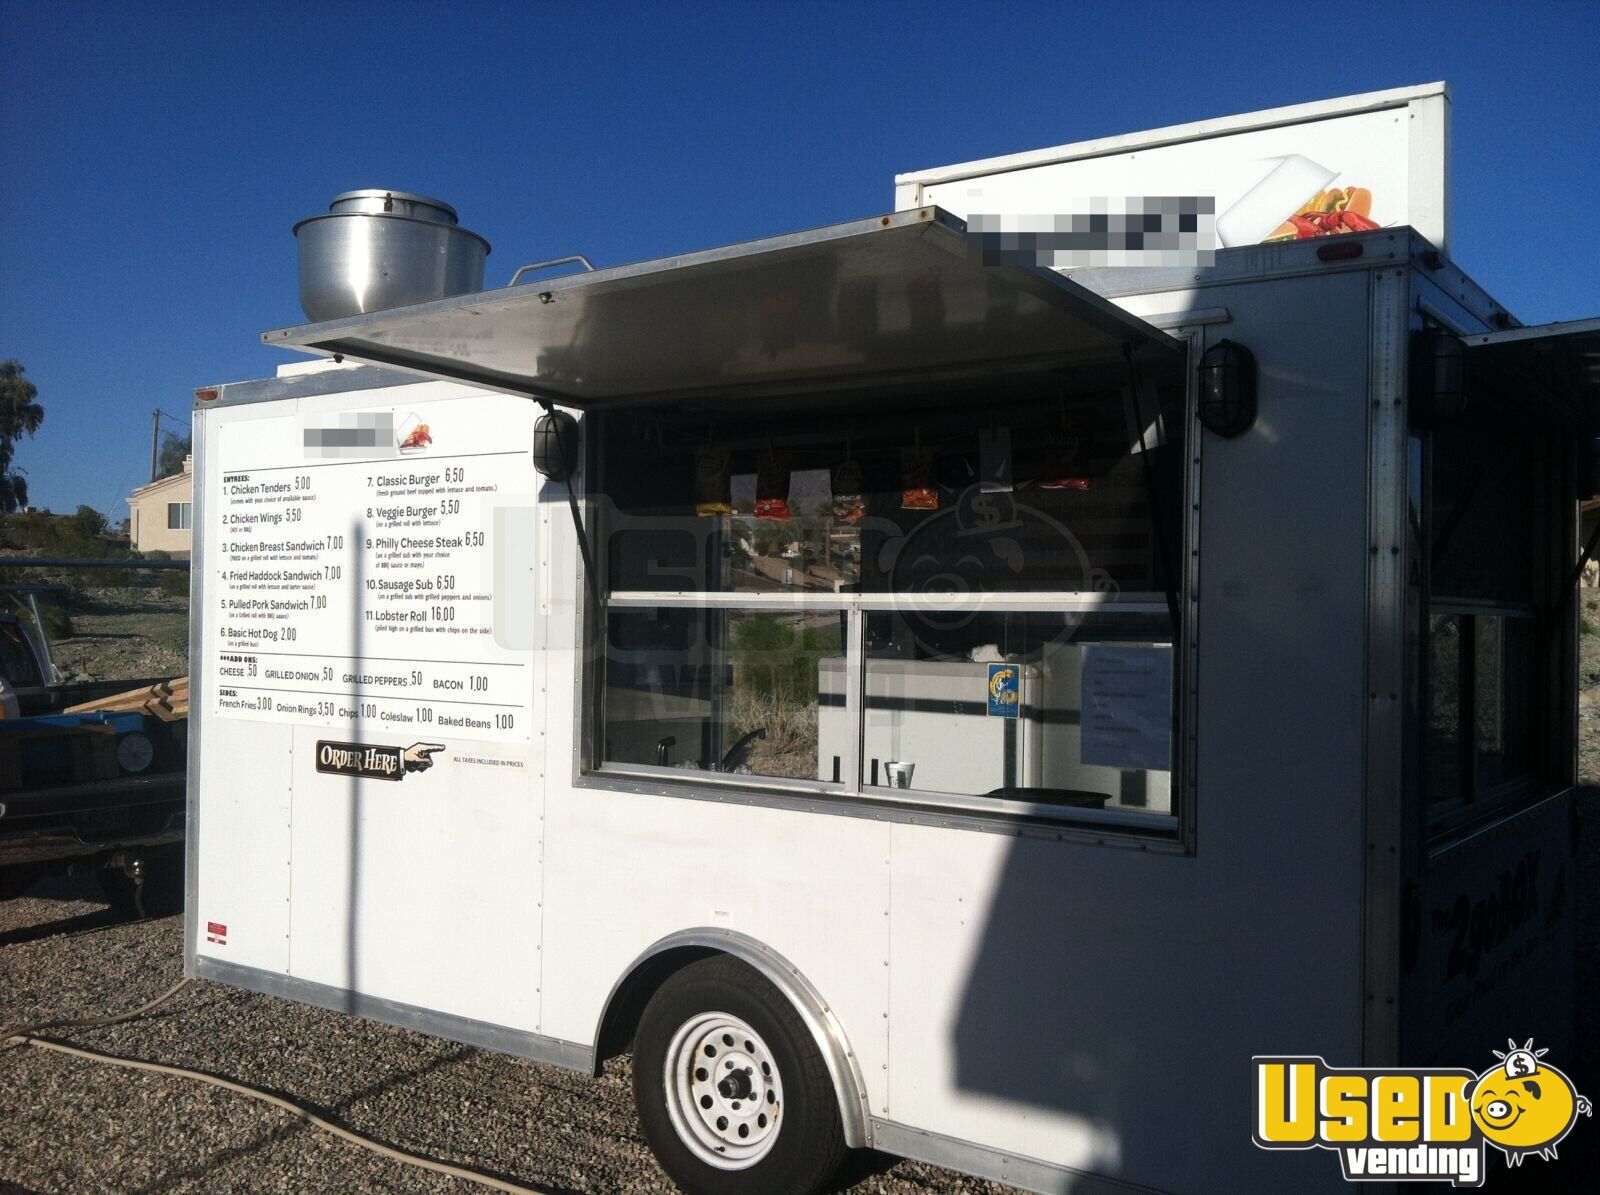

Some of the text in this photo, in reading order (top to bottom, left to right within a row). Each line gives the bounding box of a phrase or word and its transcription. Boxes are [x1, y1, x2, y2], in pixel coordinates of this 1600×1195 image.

[223, 476, 310, 495] 1. Chicken Tenders 5.00
[224, 475, 250, 483] ENTREES:
[367, 468, 464, 487] 7. Classic Burger 6.50
[223, 508, 301, 525] 2. Chicken Wings 5.50
[367, 500, 459, 520] 8. Veggie Burger 5.50
[222, 536, 343, 552] 3. Chicken Breast Sandwich 7.00
[367, 532, 484, 550] 9. Philly Cheese Steak 6.50
[222, 566, 341, 580] 4. Fried Haddock Sandwich 7.00
[366, 575, 454, 592] 10. Sausage Sub 6.50
[221, 595, 326, 610] 5. Pulled Pork Sandwich 7.00
[376, 610, 408, 621] Lobster
[410, 611, 426, 621] Roll
[432, 606, 454, 622] 16.00
[221, 628, 226, 637] 6.
[228, 628, 247, 637] Basic
[248, 629, 261, 638] Hot
[263, 629, 277, 641] Dog
[220, 668, 244, 676] CHEESE
[265, 670, 294, 680] GRILLED
[296, 672, 319, 680] ONION
[322, 667, 333, 681] .50
[343, 674, 373, 684] GRILLED
[375, 677, 407, 686] PEPPERS
[409, 671, 422, 686] .50
[433, 680, 463, 689] BACON
[470, 676, 488, 692] 1.00
[220, 697, 513, 729] French Fries 3.00 Onion Rings 3.50 Chips 1.00 Coleslaw 1.00 Baked Beans 1.00
[321, 745, 397, 774] ORDER HERE
